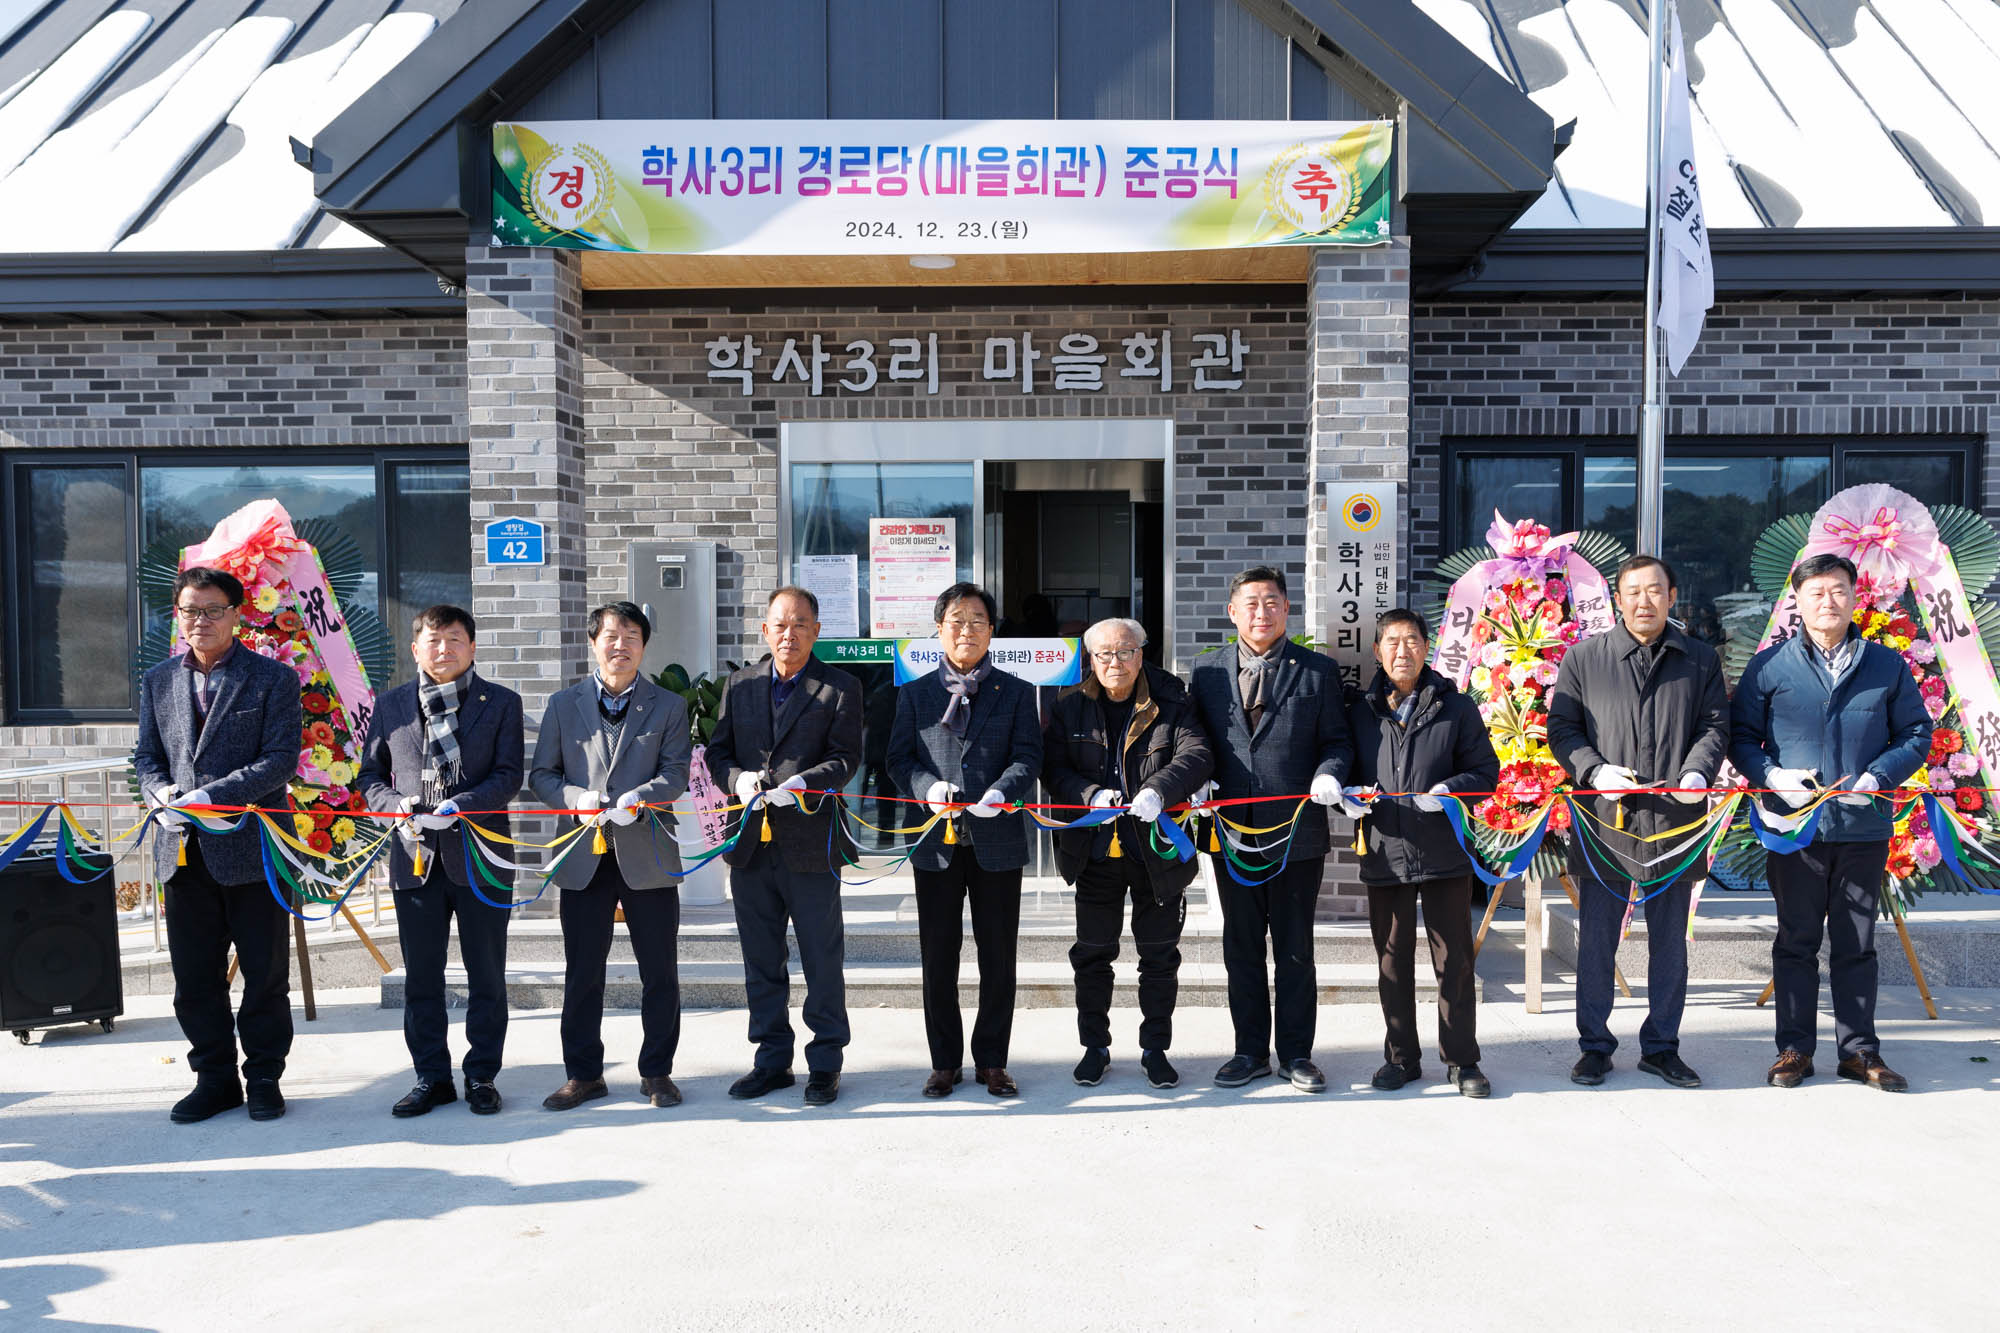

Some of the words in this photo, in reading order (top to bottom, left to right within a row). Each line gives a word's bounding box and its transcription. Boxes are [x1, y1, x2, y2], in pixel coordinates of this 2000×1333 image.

[548, 165, 585, 209] 경
[641, 144, 783, 197] 학사3리
[797, 144, 1108, 198] 경로당(마을회관)
[1123, 145, 1239, 199] 준공식
[1291, 164, 1337, 212] 축
[845, 221, 903, 239] 2024.
[916, 221, 944, 239] 12.
[957, 220, 1029, 240] 23.(월)
[704, 332, 940, 396] 학사3리
[982, 329, 1250, 395] 마을회관
[503, 541, 528, 559] 42
[1373, 542, 1390, 551] 사단
[1373, 552, 1390, 561] 법인
[1336, 541, 1364, 653] 학사3리
[836, 645, 878, 656] 학사3리
[1034, 649, 1065, 664] 준공식
[1440, 606, 1474, 682] 다솔
